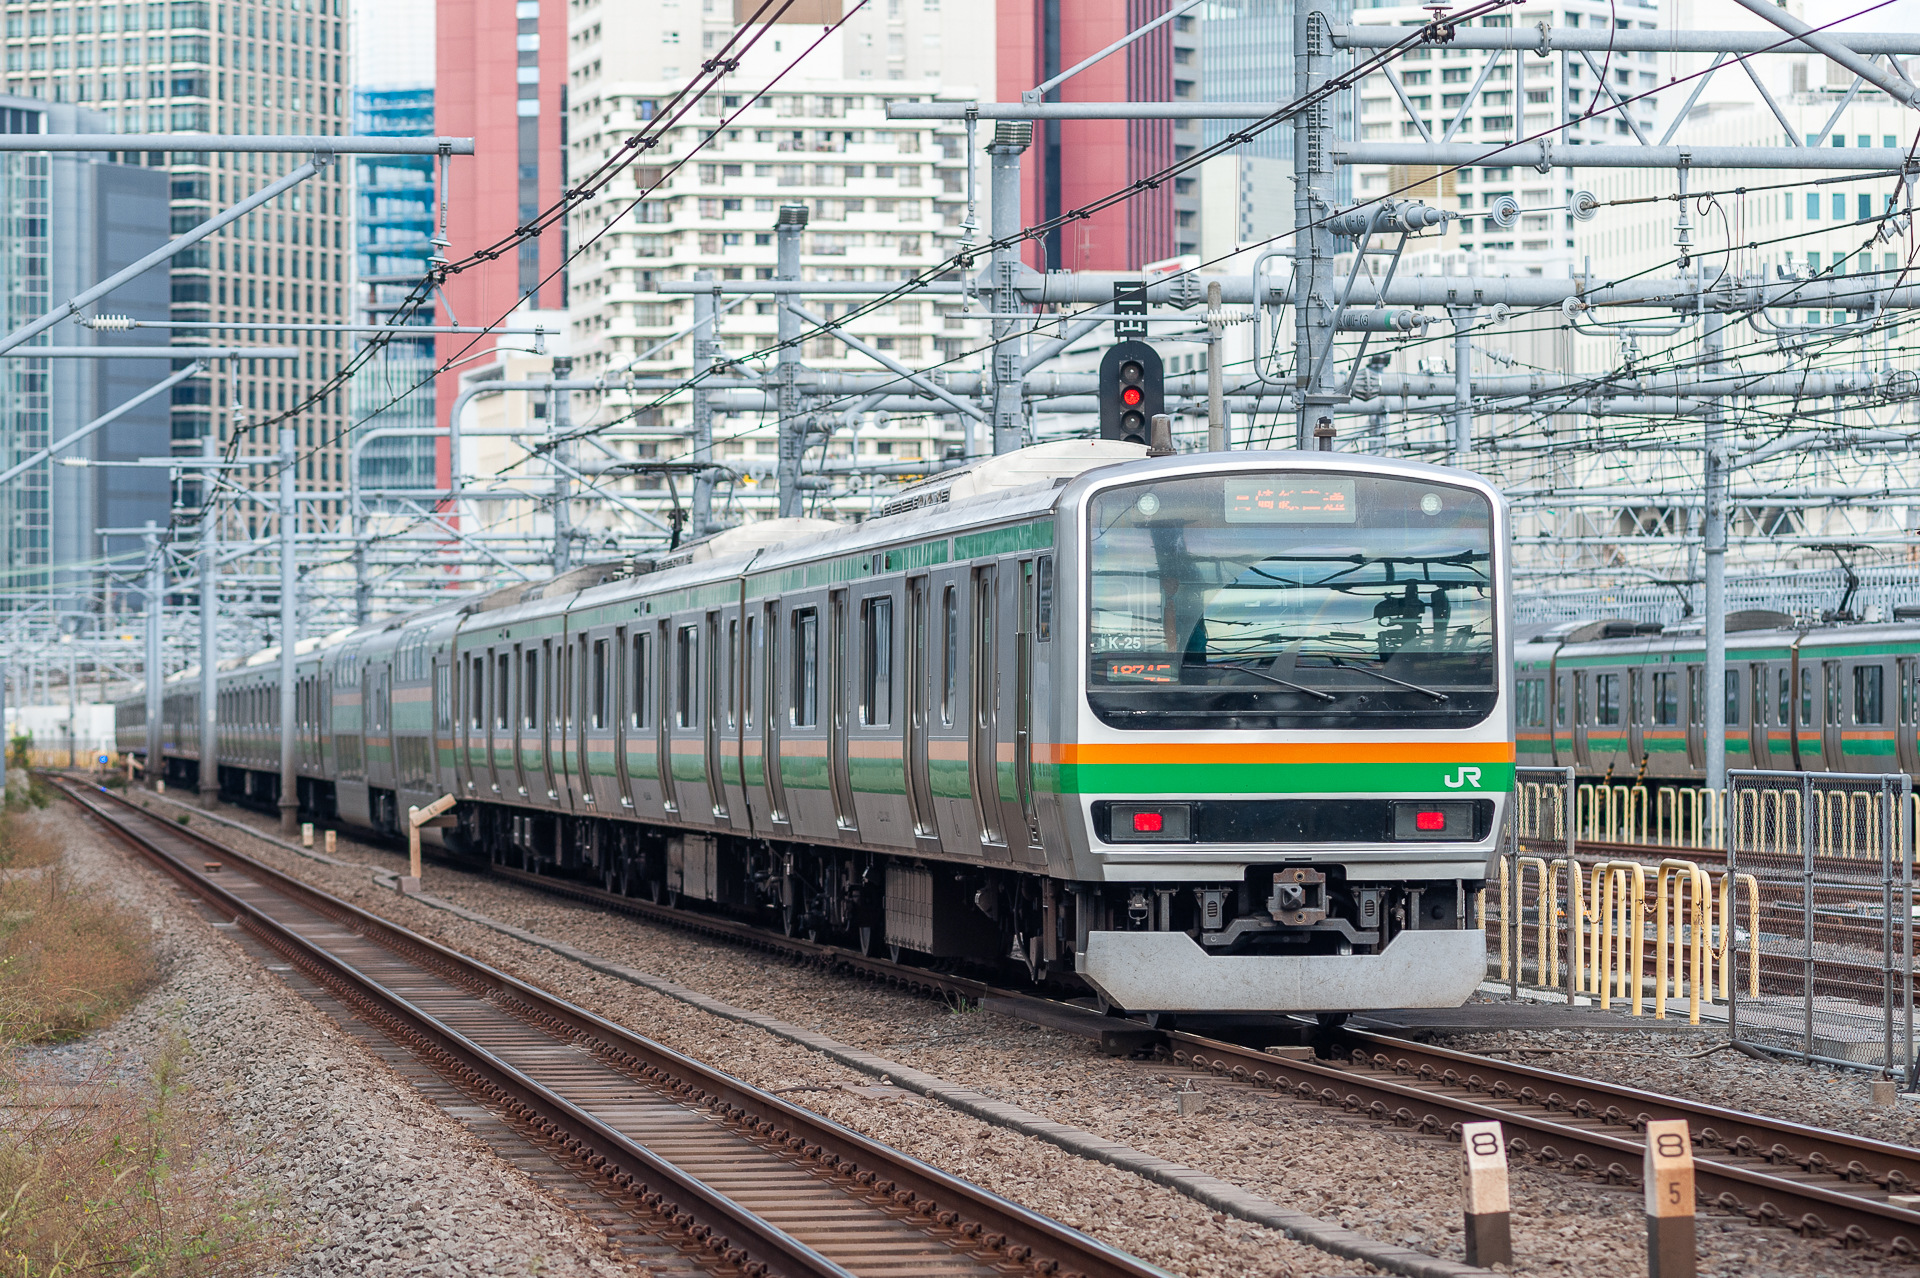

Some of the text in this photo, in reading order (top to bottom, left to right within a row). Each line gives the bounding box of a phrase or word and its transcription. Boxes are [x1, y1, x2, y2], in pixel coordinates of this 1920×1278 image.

[1108, 636, 1142, 650] K-25
[1444, 766, 1482, 788] JR
[1471, 1132, 1498, 1156] 8
[1657, 1133, 1684, 1157] 8
[1669, 1182, 1681, 1205] 5
